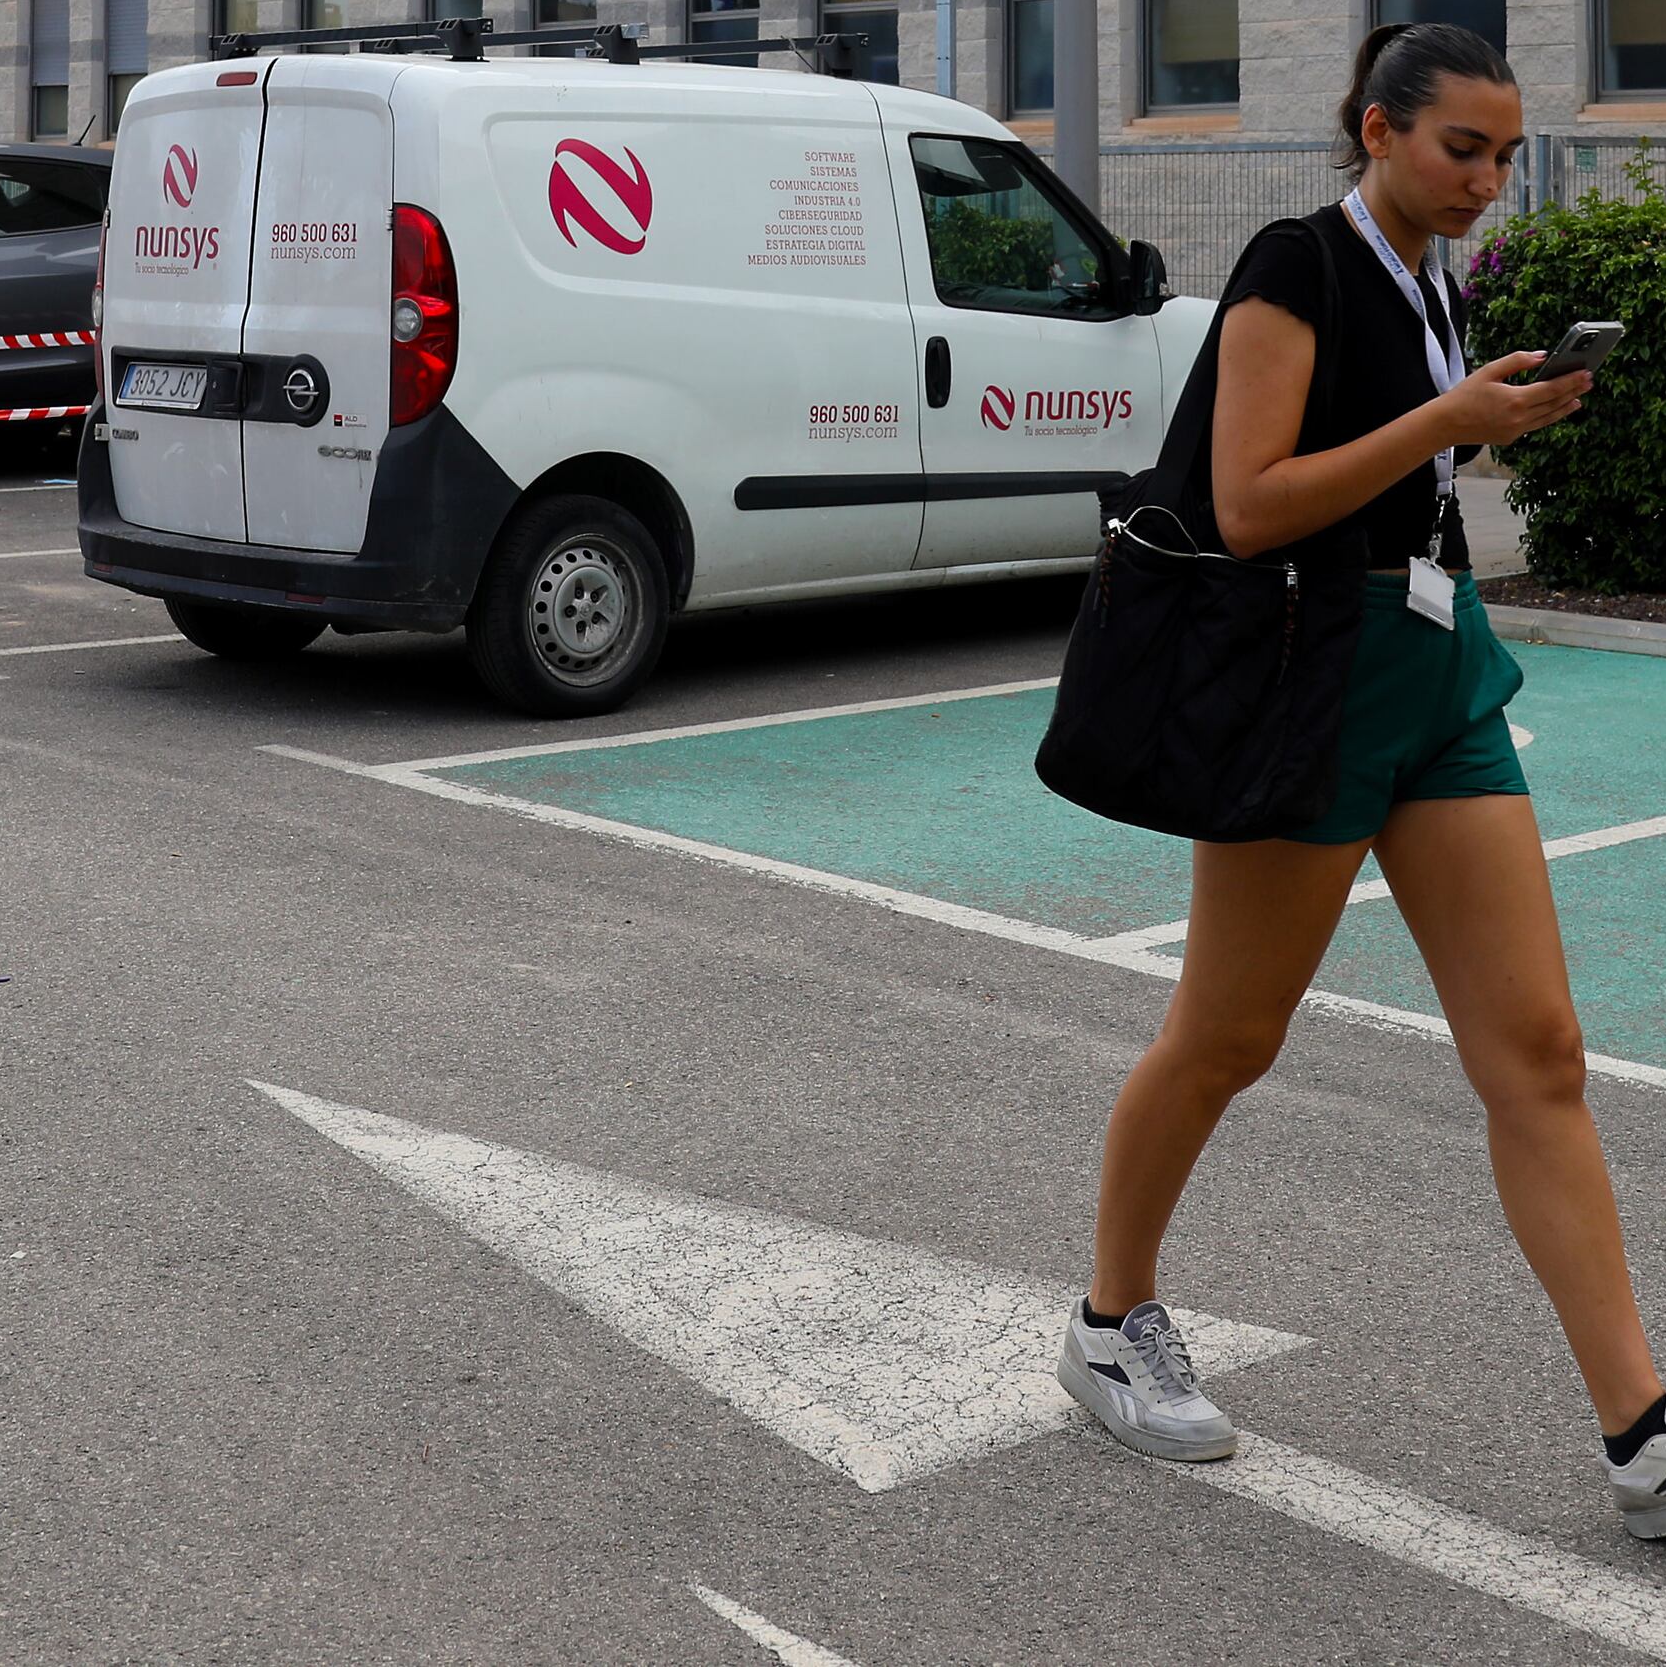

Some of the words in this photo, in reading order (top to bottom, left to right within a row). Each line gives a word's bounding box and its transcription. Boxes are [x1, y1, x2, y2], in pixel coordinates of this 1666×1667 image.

[804, 151, 856, 163] SOFTWARE
[810, 166, 857, 177] SISTEMAS
[769, 179, 859, 192] COMUNICACIONES
[794, 195, 845, 206] INDUSTRIA
[847, 196, 861, 207] 4.0
[778, 209, 863, 221] CIBERSEGURIDAD
[271, 223, 297, 243] 960
[301, 223, 327, 243] 500
[332, 223, 358, 242] 631
[764, 224, 828, 235] SOLUCIONES
[830, 225, 864, 236] CLOUD
[134, 225, 220, 270] nunsys
[765, 239, 826, 251] ESTRATEGIA
[828, 240, 866, 251] DIGITAL
[270, 245, 357, 264] nunsys.com
[748, 254, 787, 265] MEDIOS
[790, 254, 867, 265] AUDIOVISUALES
[130, 368, 170, 397] 3052
[170, 370, 207, 399] JCY
[809, 405, 838, 423] 960
[842, 405, 870, 422] 500
[874, 405, 900, 422] 631
[1024, 389, 1133, 428] nunsys
[808, 425, 898, 443] nunsys.com
[1024, 425, 1033, 436] Tu
[1035, 426, 1054, 436] socio
[1056, 425, 1098, 437] tecnológico
